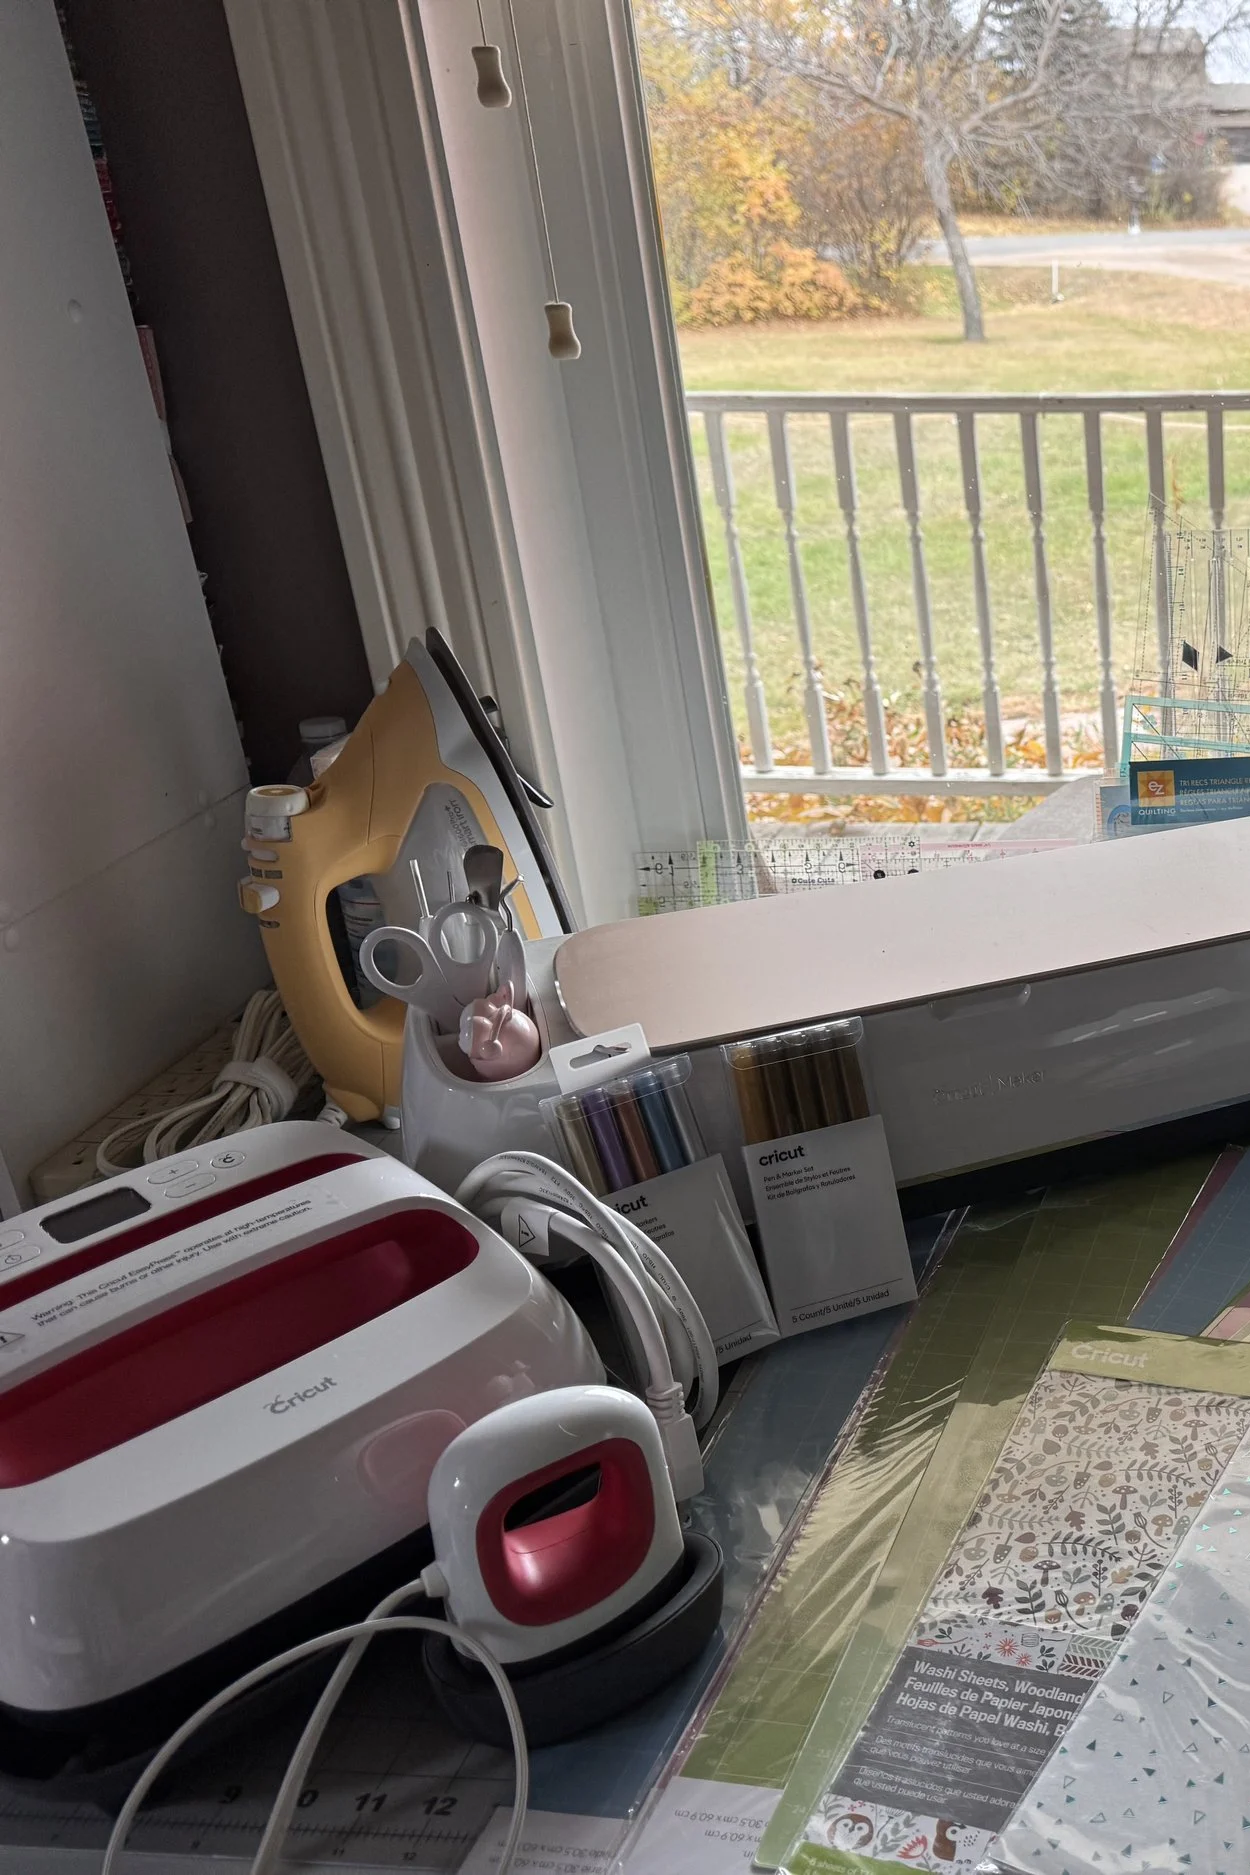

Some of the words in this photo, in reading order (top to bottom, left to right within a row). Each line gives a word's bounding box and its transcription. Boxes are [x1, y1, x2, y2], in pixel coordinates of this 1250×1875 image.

[1210, 778, 1243, 786] TRIANGLE
[1138, 808, 1176, 816] QUILTING
[759, 1145, 805, 1166] cricut
[764, 1174, 776, 1183] Pen
[782, 1168, 803, 1179] Marker
[804, 1165, 814, 1174] Set
[765, 1181, 795, 1192] Ensemble
[795, 1178, 804, 1186] de
[804, 1174, 822, 1185] Stylos
[829, 1166, 851, 1177] Feutres
[767, 1192, 777, 1201] Kit
[776, 1190, 785, 1199] de
[820, 1174, 856, 1188] Rotuladores
[614, 1195, 649, 1216] icut
[636, 1216, 658, 1229] arkers
[30, 1298, 74, 1322] Warning:
[76, 1283, 98, 1300] This
[98, 1271, 128, 1291] Cricut
[183, 1234, 223, 1255] operates
[37, 1315, 58, 1328] that
[60, 1306, 76, 1318] can
[78, 1291, 108, 1310] cause
[109, 1278, 139, 1296] burns
[150, 1259, 176, 1277] other
[203, 1241, 221, 1254] Use
[222, 1231, 243, 1246] with
[792, 1314, 798, 1324] 5
[799, 1305, 832, 1322] Count/5
[862, 1290, 890, 1305] Unidad
[724, 1334, 752, 1351] Unidad
[1071, 1343, 1150, 1369] Cricut
[263, 1377, 337, 1414] Cricut
[913, 1660, 956, 1682] Washi
[958, 1670, 1010, 1692] Sheets,
[1014, 1680, 1086, 1705] Woodland
[904, 1677, 958, 1699] Feuilles
[960, 1689, 979, 1702] de
[981, 1692, 1027, 1715] Papier
[896, 1693, 937, 1715] Hojas
[939, 1703, 958, 1717] de
[959, 1706, 1003, 1728] Papel
[1003, 1713, 1051, 1737] Washi,
[887, 1715, 936, 1735] Translucent
[937, 1725, 973, 1741] patterns
[974, 1734, 990, 1746] you
[991, 1737, 1010, 1748] love
[1010, 1740, 1020, 1751] at
[1029, 1746, 1046, 1756] size
[875, 1735, 892, 1748] Des
[922, 1744, 974, 1765] translucides
[975, 1758, 993, 1770] que
[994, 1761, 1014, 1772] vous
[909, 1754, 942, 1770] pouvez
[942, 1760, 973, 1776] utiliser
[296, 1789, 319, 1810] 0
[353, 1794, 387, 1813] 11
[422, 1796, 458, 1817] 12
[898, 1787, 927, 1803] puede
[945, 1785, 962, 1798] que
[962, 1788, 989, 1803] usted
[674, 1809, 690, 1818] cm
[690, 1811, 715, 1822] 60.9
[724, 1815, 739, 1824] cm
[740, 1818, 764, 1829] 30.5
[704, 1829, 720, 1839] cm
[721, 1832, 745, 1842] 60.9
